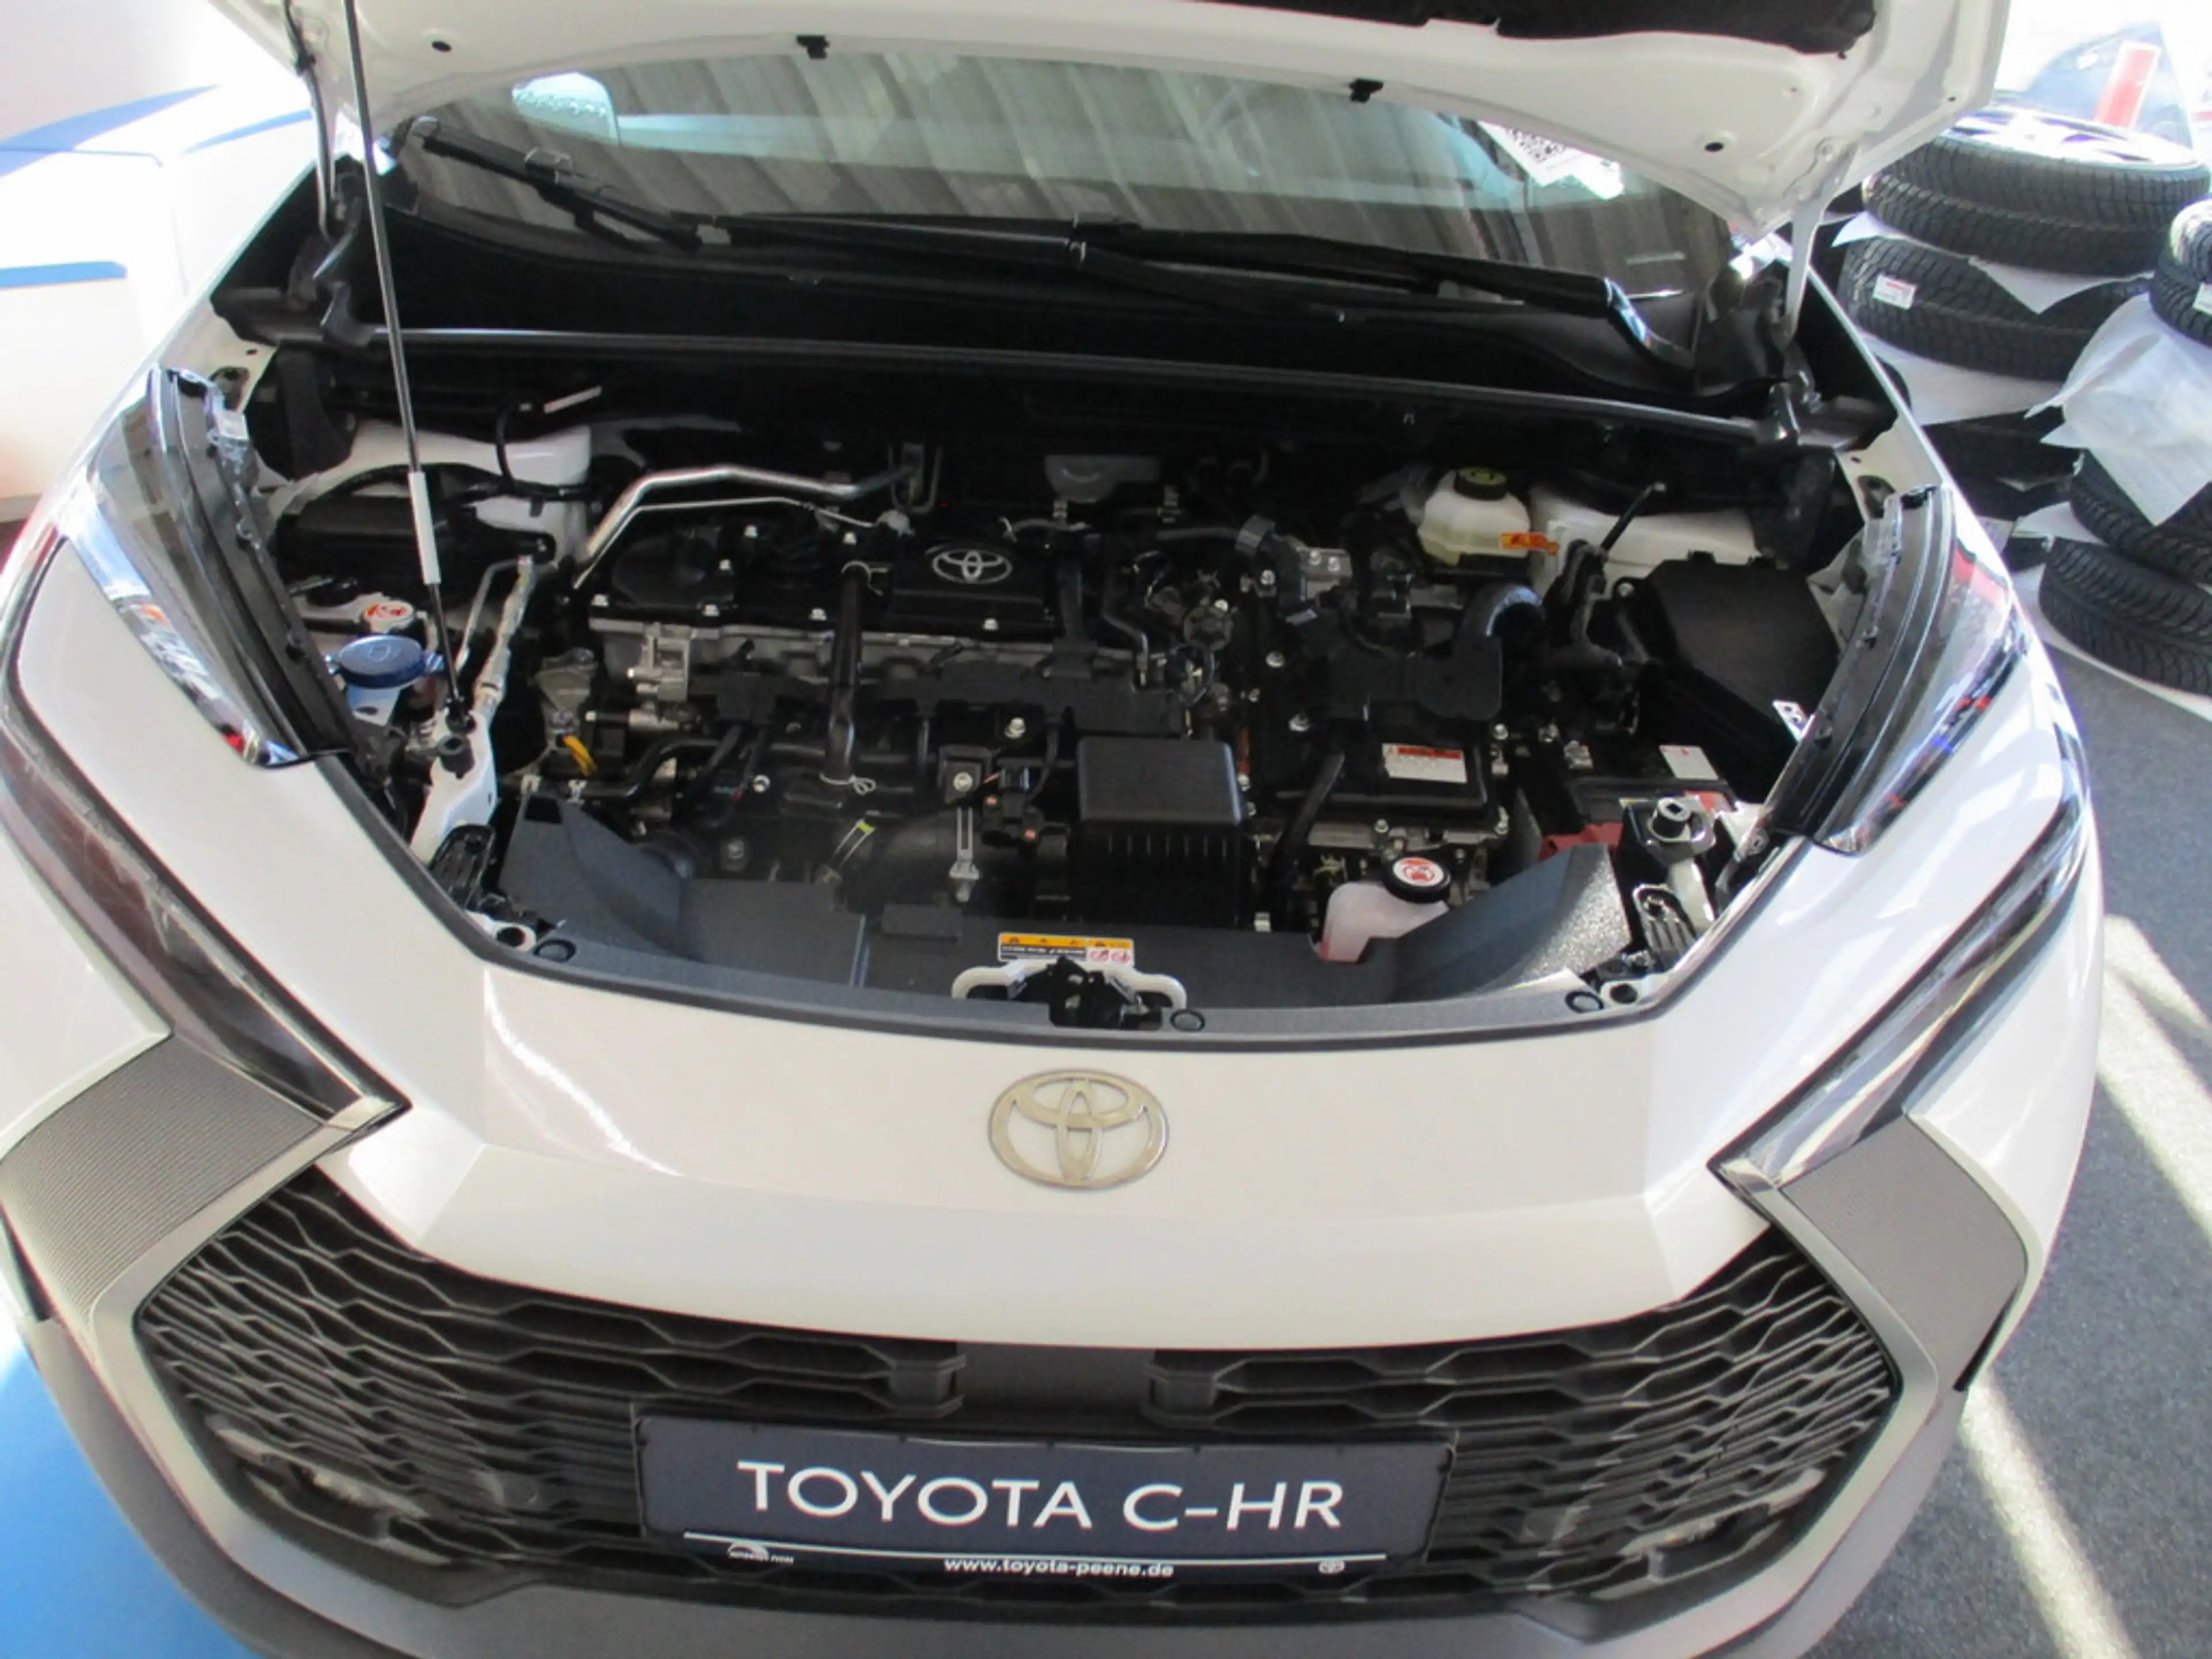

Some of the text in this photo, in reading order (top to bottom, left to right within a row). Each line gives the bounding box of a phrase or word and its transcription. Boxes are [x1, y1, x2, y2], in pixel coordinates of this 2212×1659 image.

[737, 1461, 1343, 1530] TOYOTA C-HR
[944, 1558, 1175, 1577] www.toyota-peene.de
